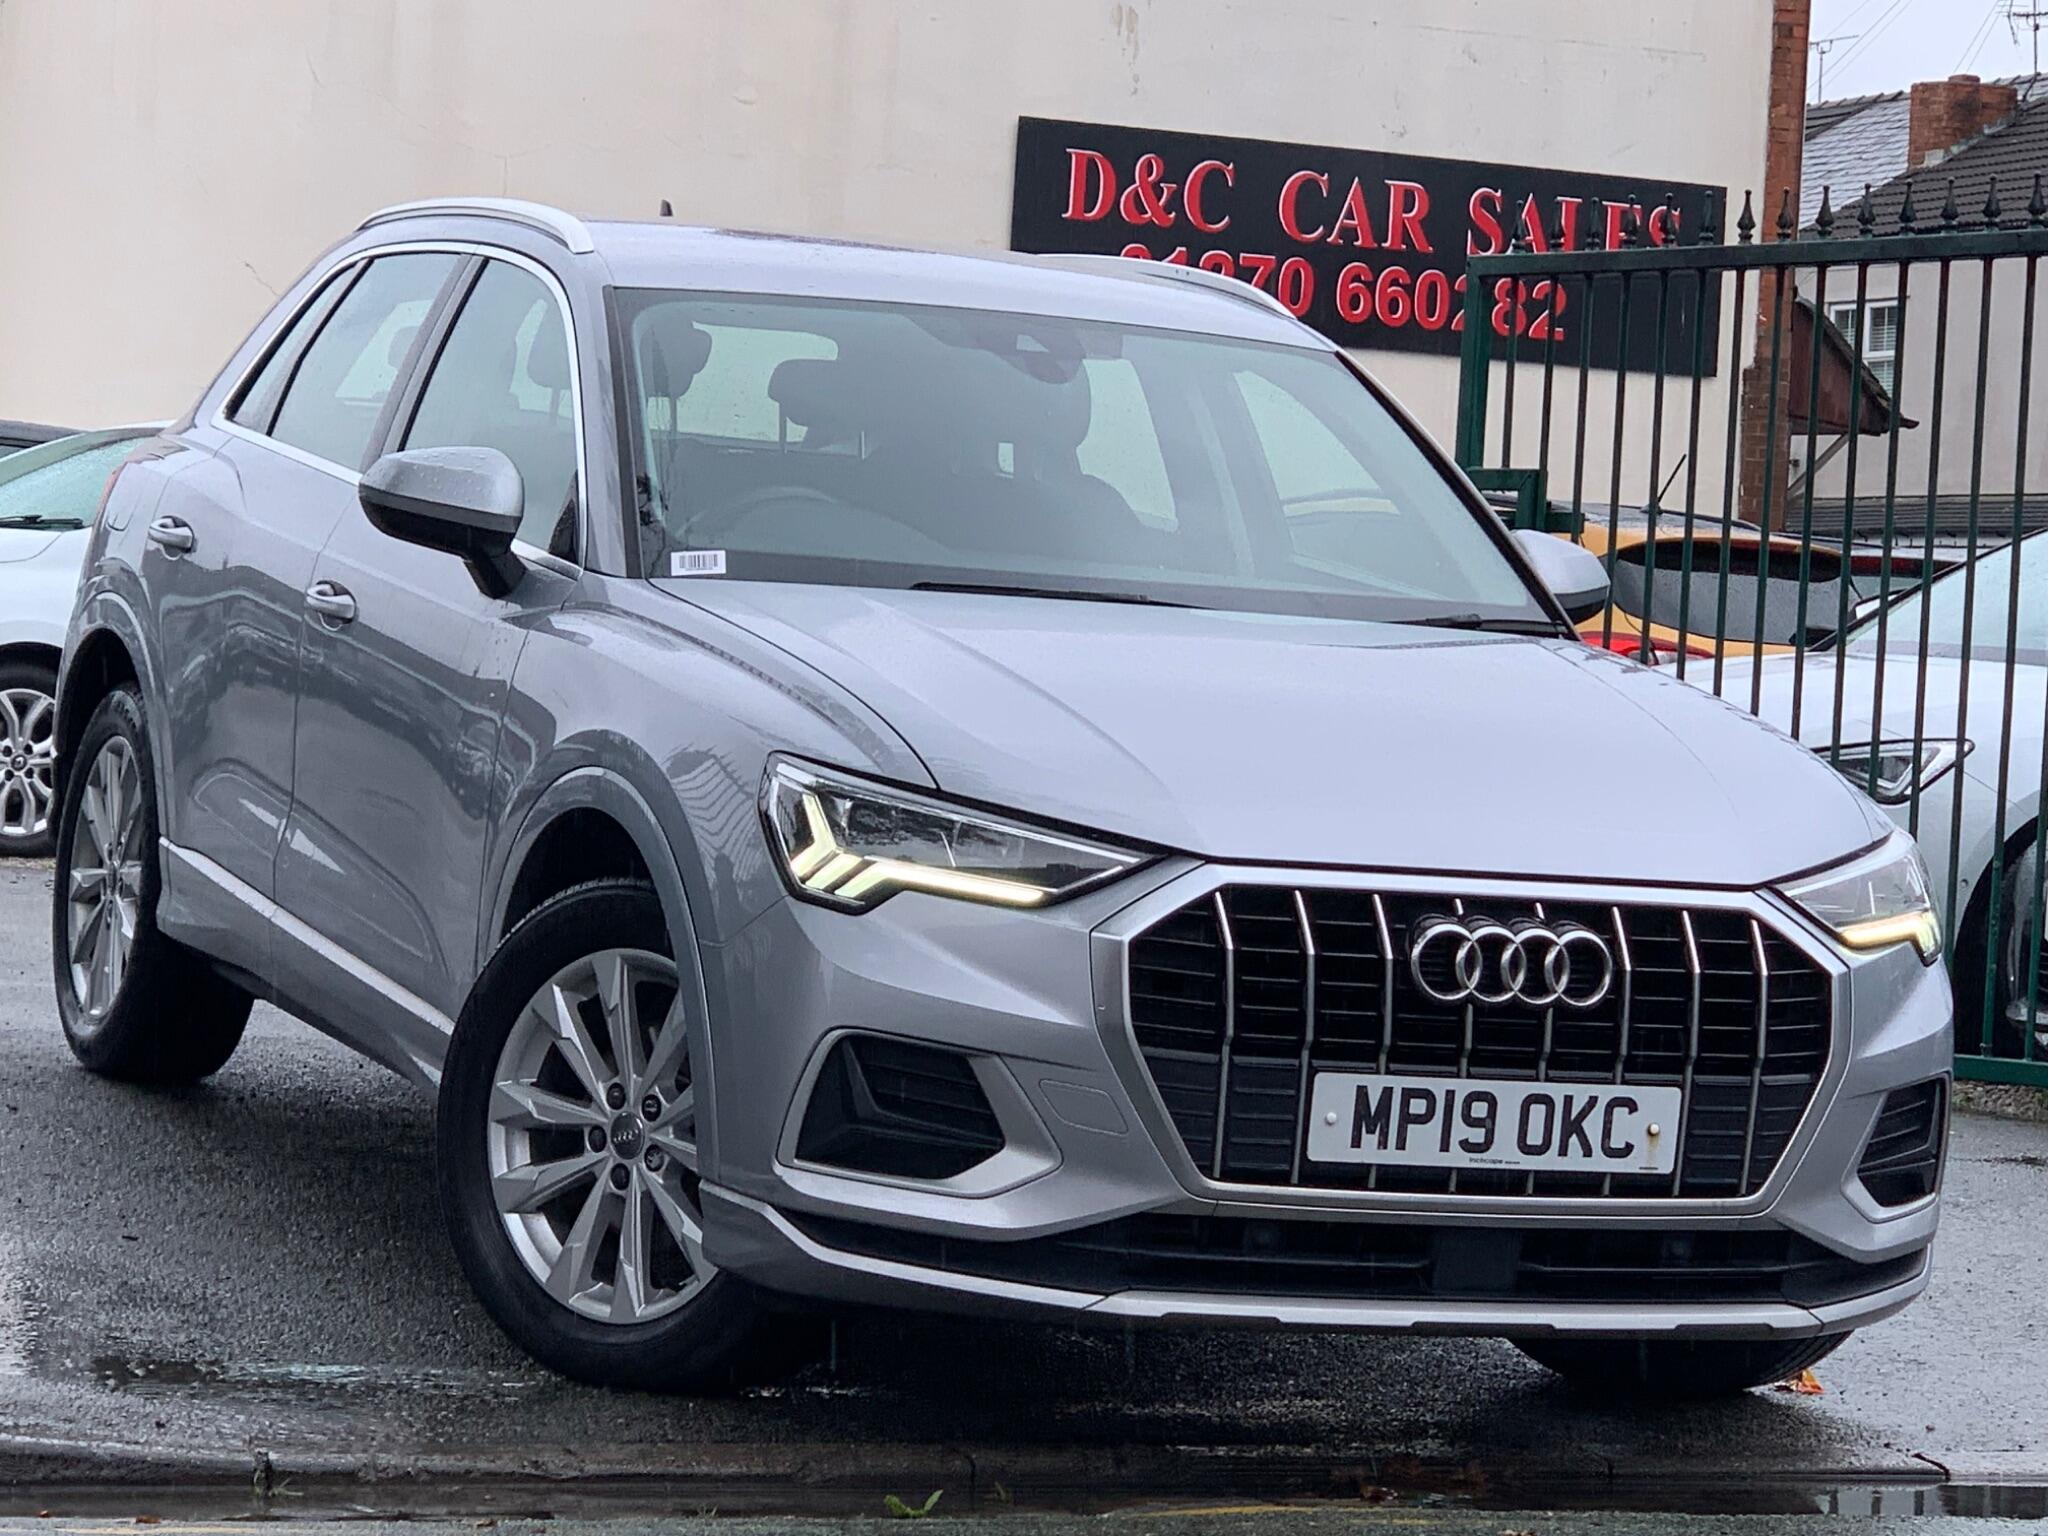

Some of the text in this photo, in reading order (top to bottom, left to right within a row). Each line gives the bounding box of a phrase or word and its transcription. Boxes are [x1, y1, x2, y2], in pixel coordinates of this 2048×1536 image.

[1063, 149, 1235, 232] D&C
[1278, 171, 1432, 254] CAR
[1350, 1085, 1639, 1158] MP19 OKC
